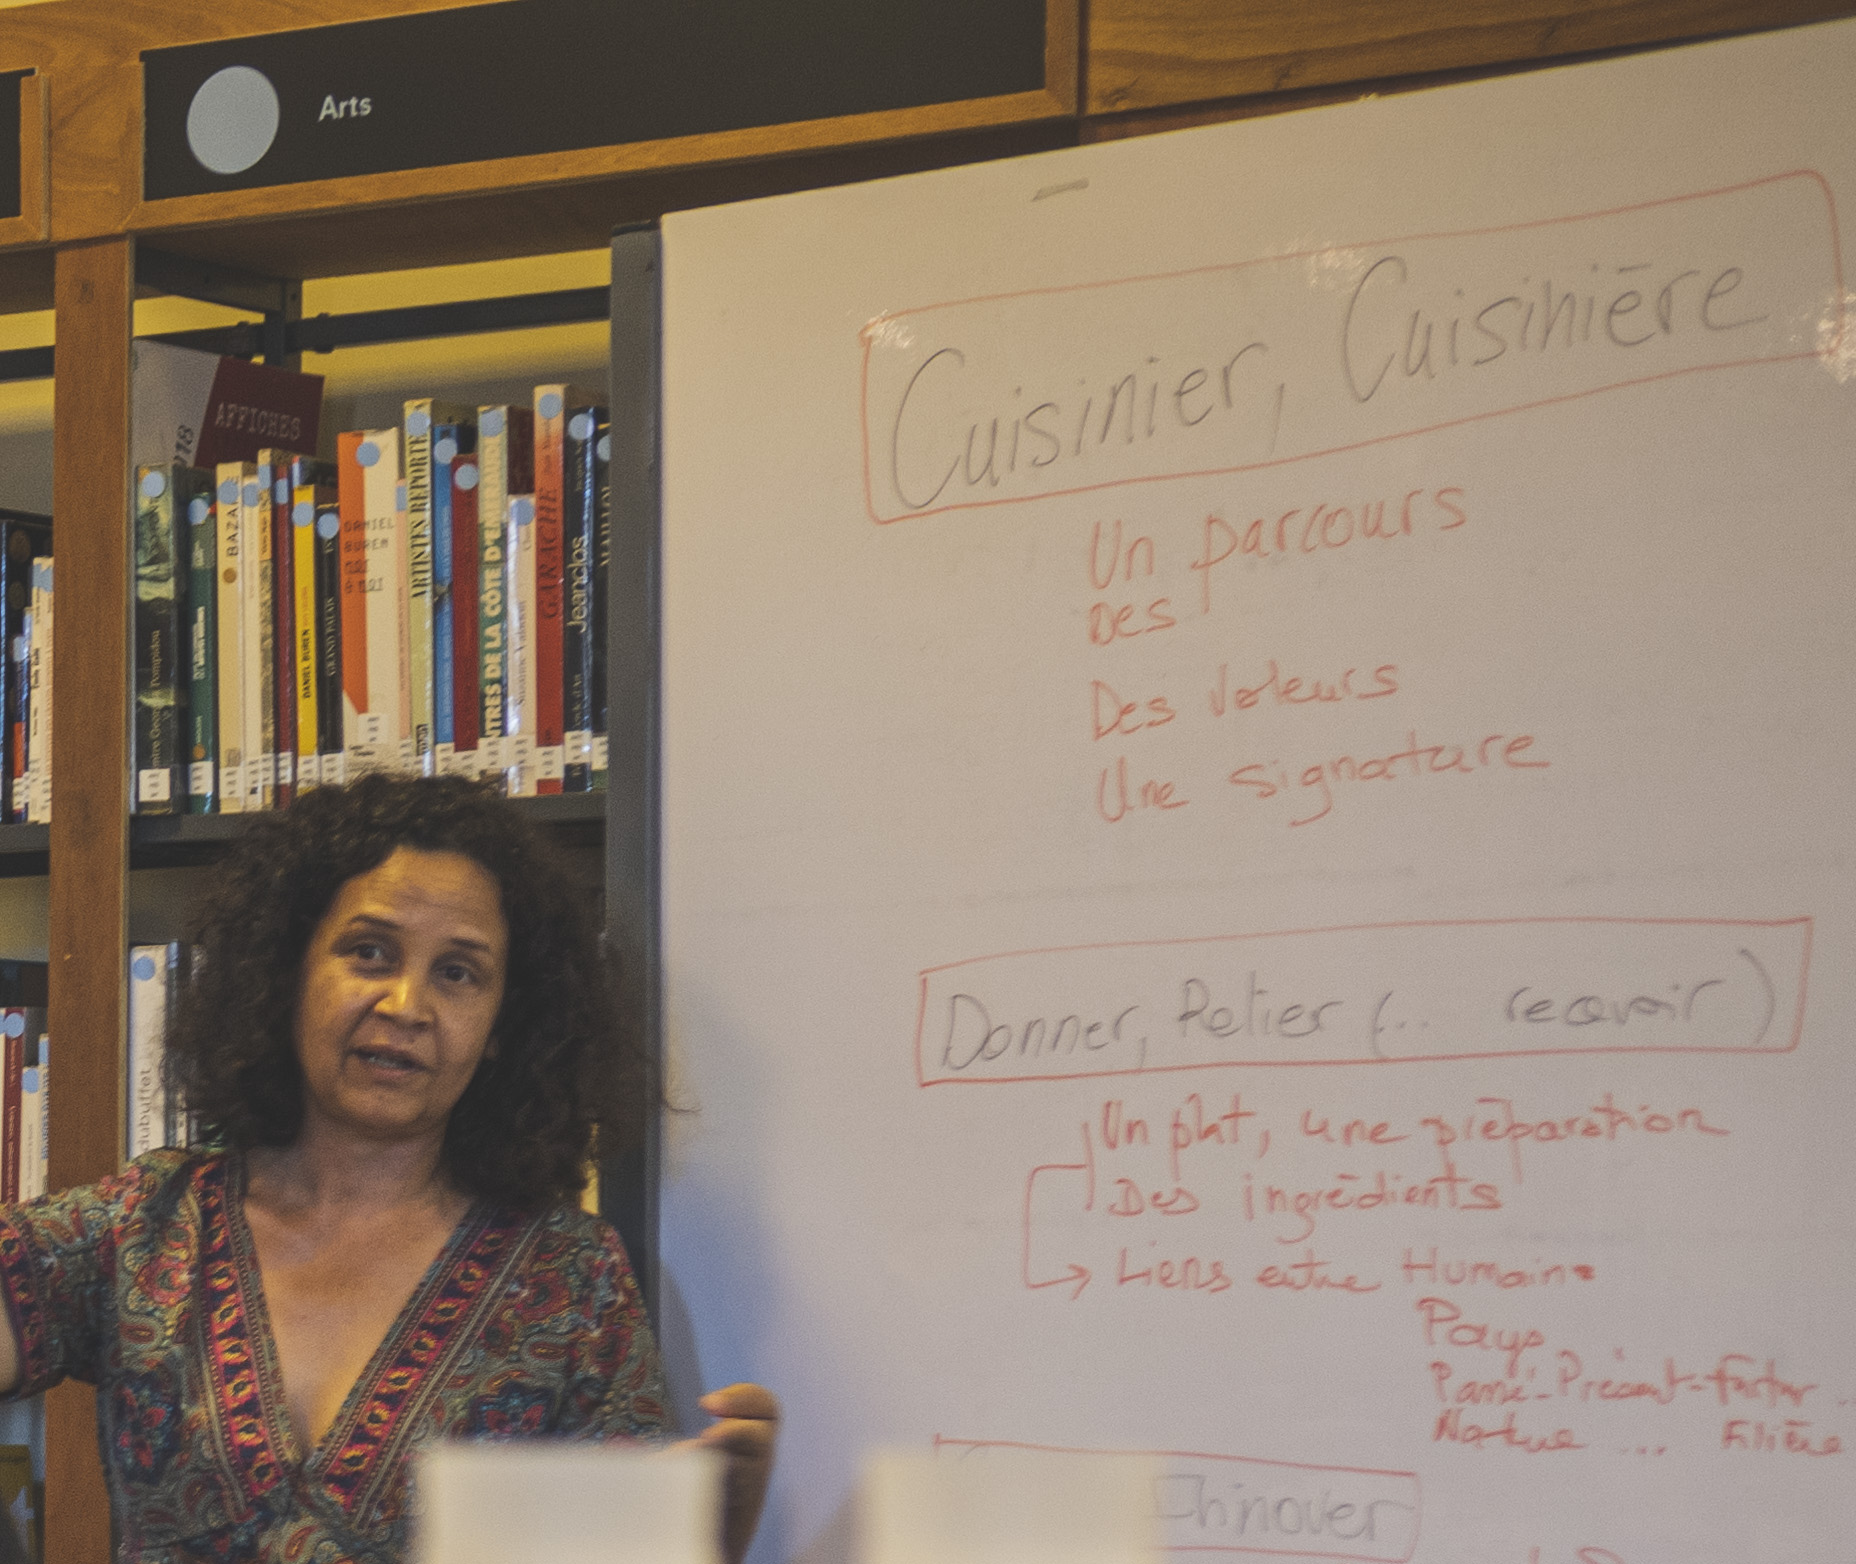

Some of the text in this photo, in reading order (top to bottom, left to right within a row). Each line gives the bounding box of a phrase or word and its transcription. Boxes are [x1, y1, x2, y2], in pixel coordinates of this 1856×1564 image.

[318, 95, 372, 121] Arts
[214, 402, 301, 442] AFFICHES
[892, 342, 1287, 510] Cuisinier,
[411, 520, 430, 599] ARTISTES
[567, 535, 588, 634] Jeanclos
[1087, 486, 1468, 615] Un parcours
[478, 568, 501, 617] CÔTE
[481, 653, 502, 677] DE
[482, 624, 502, 648] LA
[1092, 680, 1177, 740] Des
[1097, 732, 1549, 827] Une signature
[942, 994, 1148, 1071] Donner,
[1180, 968, 1345, 1038] Relier
[1102, 1100, 1150, 1149] Un
[1170, 1093, 1271, 1181] plat,
[1300, 1109, 1411, 1146] une
[1109, 1162, 1503, 1243] Des ingrédients
[1117, 1240, 1232, 1291] Liens
